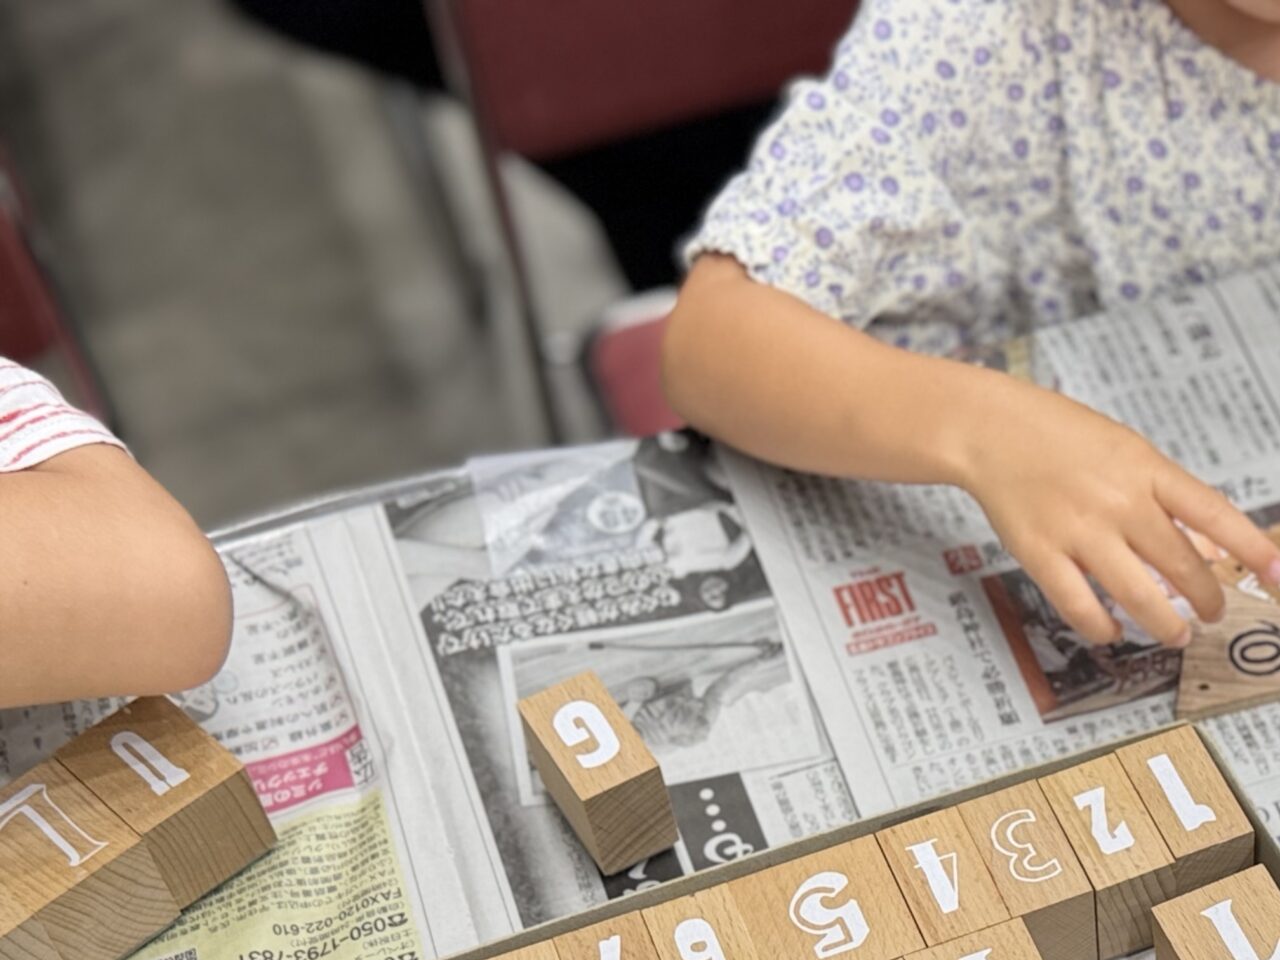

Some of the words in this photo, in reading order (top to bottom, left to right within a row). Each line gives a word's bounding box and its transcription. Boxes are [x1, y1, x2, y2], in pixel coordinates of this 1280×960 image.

[832, 571, 919, 631] FIRST
[551, 699, 622, 770] G
[1073, 785, 1137, 856] 2
[1145, 753, 1218, 833] 1
[906, 836, 960, 914] 4
[989, 807, 1063, 884] 3
[788, 870, 872, 960] 5
